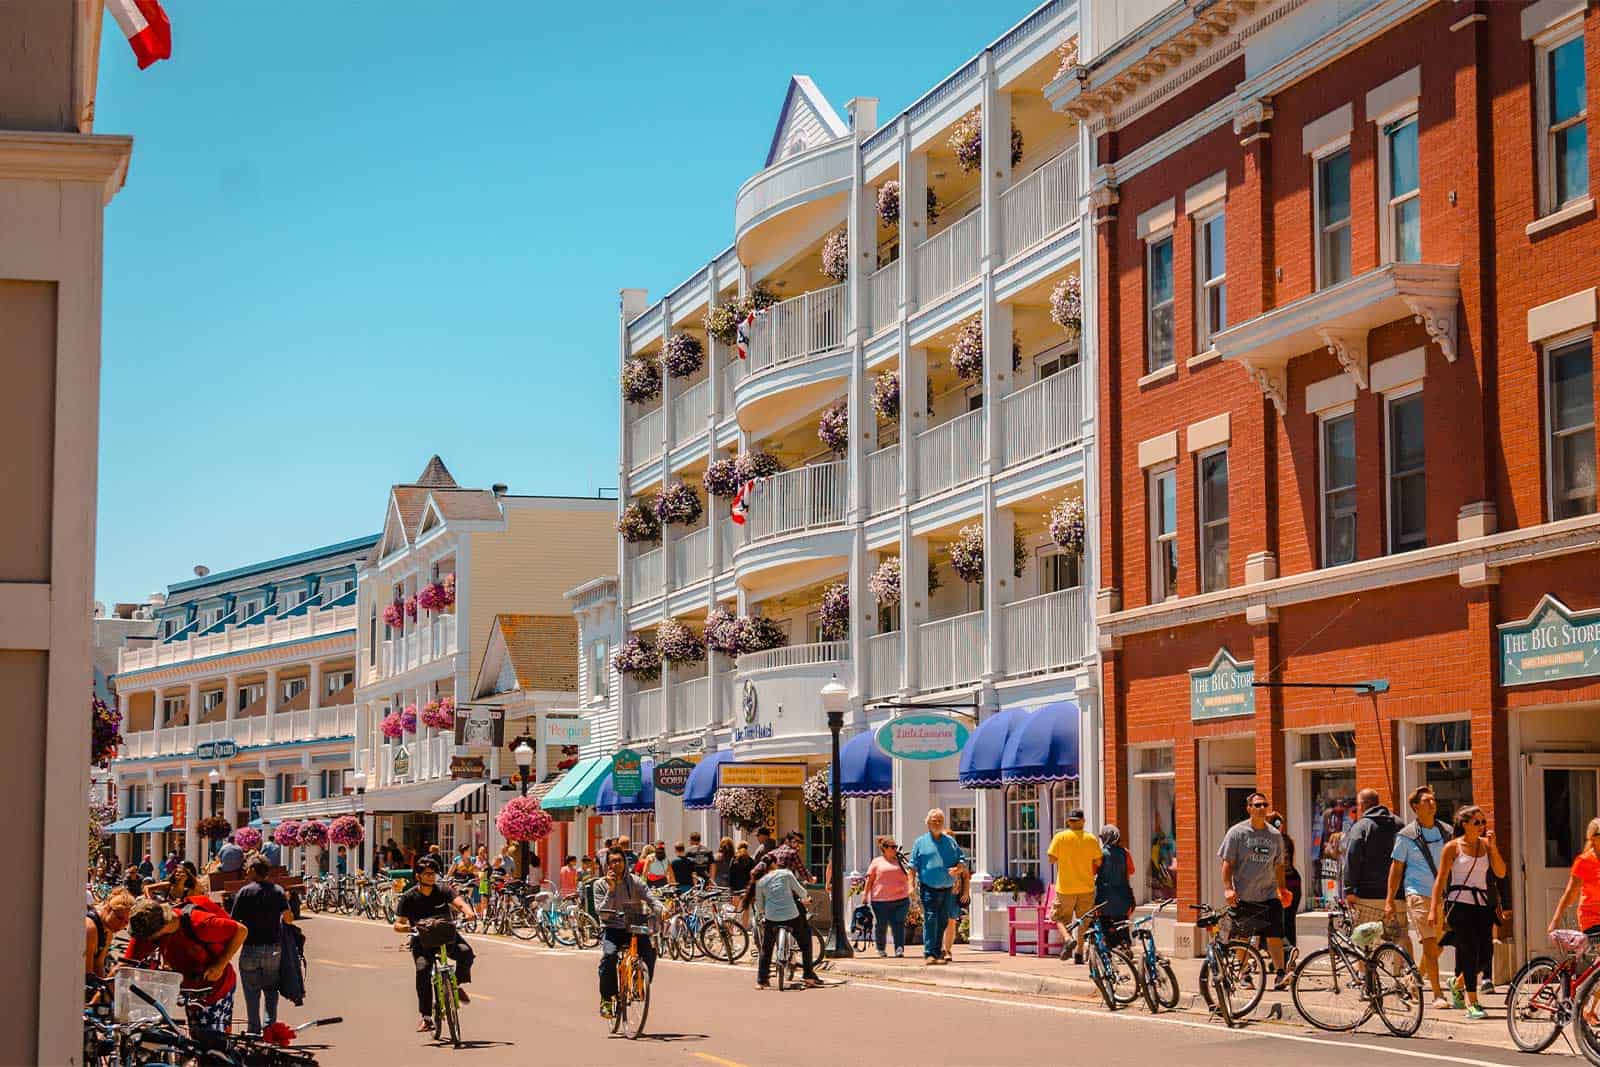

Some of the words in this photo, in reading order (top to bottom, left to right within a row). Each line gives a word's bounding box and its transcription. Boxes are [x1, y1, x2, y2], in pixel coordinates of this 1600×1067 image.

[1503, 633, 1528, 654] THE
[1531, 626, 1558, 650] BIG
[1211, 672, 1229, 691] BIG
[659, 768, 692, 777] LEATHE
[660, 776, 688, 785] CORRA
